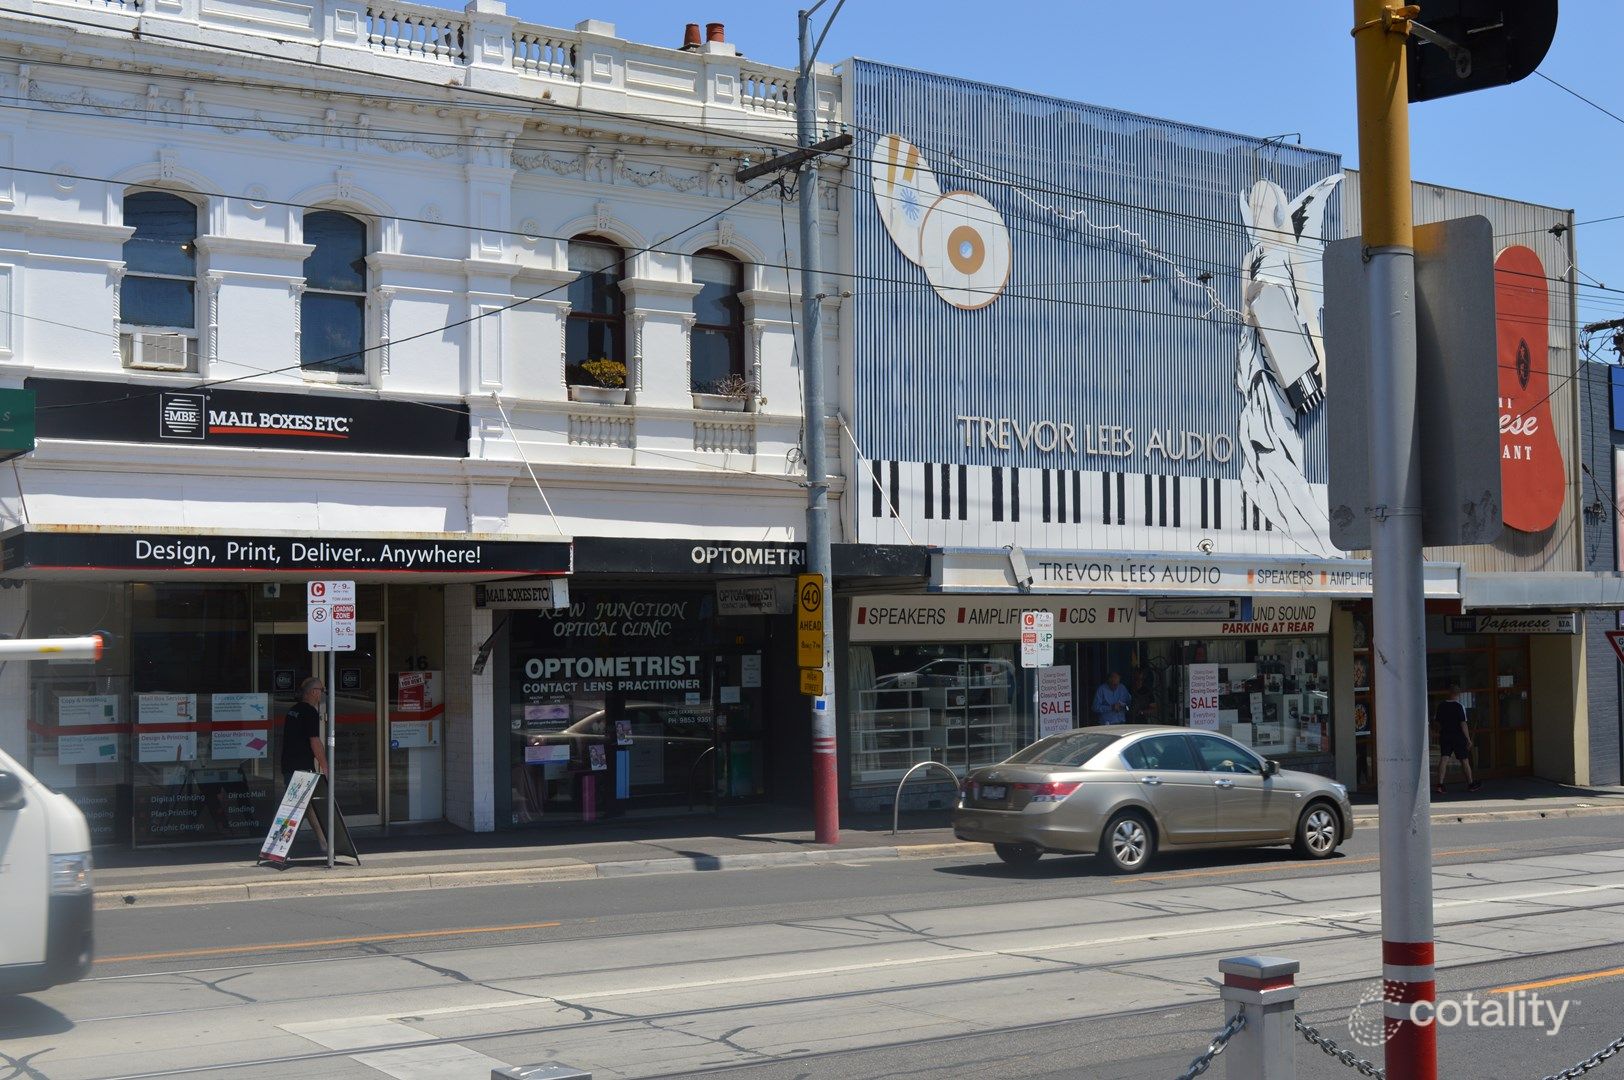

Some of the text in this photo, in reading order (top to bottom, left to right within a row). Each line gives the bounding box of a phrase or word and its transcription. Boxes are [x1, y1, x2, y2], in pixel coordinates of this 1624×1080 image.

[169, 411, 196, 422] MBE
[209, 410, 257, 427] MAIL
[259, 413, 314, 430] BOXES
[1499, 414, 1538, 436] ese
[957, 414, 1233, 463] TREVOR LEES AUDIO
[1502, 444, 1532, 460] ANT
[135, 540, 481, 567] Design, Print, Deliver... Anywhere!
[691, 546, 805, 565] OPTOMETRI
[1039, 562, 1221, 584] TREVOR LEES AUDIO
[1257, 569, 1314, 585] SPEAKERS
[1330, 571, 1373, 585] AMPLIFIE
[486, 588, 506, 603] MAIL
[507, 587, 532, 602] BOXES
[803, 589, 819, 604] 40
[595, 601, 688, 620] JUNCTION
[868, 607, 946, 625] SPEAKERS
[968, 607, 1049, 625] AMPLIFI
[1069, 607, 1096, 623] CDS
[1117, 607, 1134, 623] TV
[1253, 606, 1317, 621] UND SOUND
[553, 621, 672, 638] OPTICAL CLINIC
[800, 620, 822, 631] AHEAD
[1222, 622, 1315, 634] PARKING AT REAR
[1479, 614, 1551, 632] Japanese
[525, 655, 700, 679] OPTOMETRIST
[523, 679, 700, 694] CONTACT LENS PRACTITIONER
[1040, 700, 1071, 714] SALE
[1190, 696, 1218, 709] SALE
[151, 793, 206, 804] Digital Printing
[228, 790, 266, 799] Direct Mail
[86, 811, 114, 819] hipping
[168, 808, 197, 818] Printing
[228, 805, 255, 814] Binding
[151, 823, 205, 834] Graphic Design
